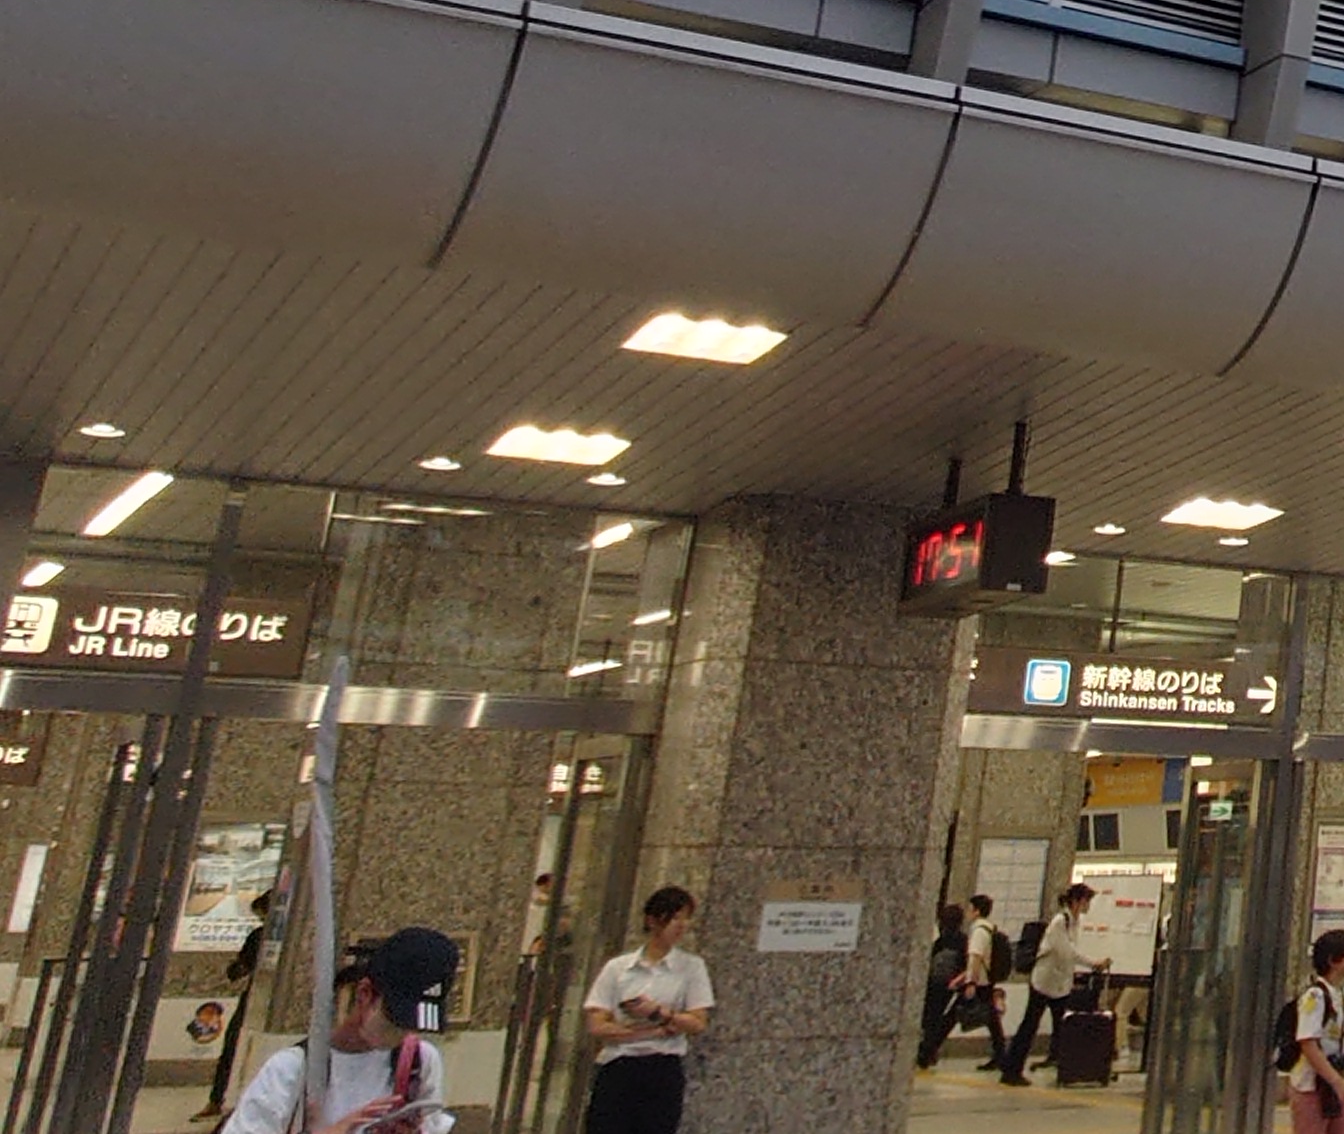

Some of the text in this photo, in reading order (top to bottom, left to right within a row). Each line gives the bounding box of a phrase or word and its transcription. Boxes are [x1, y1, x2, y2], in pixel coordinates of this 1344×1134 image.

[69, 635, 169, 659] JR Line
[1081, 664, 1224, 695] 新幹線のりば
[1079, 692, 1235, 714] Shinkansen Tracks
